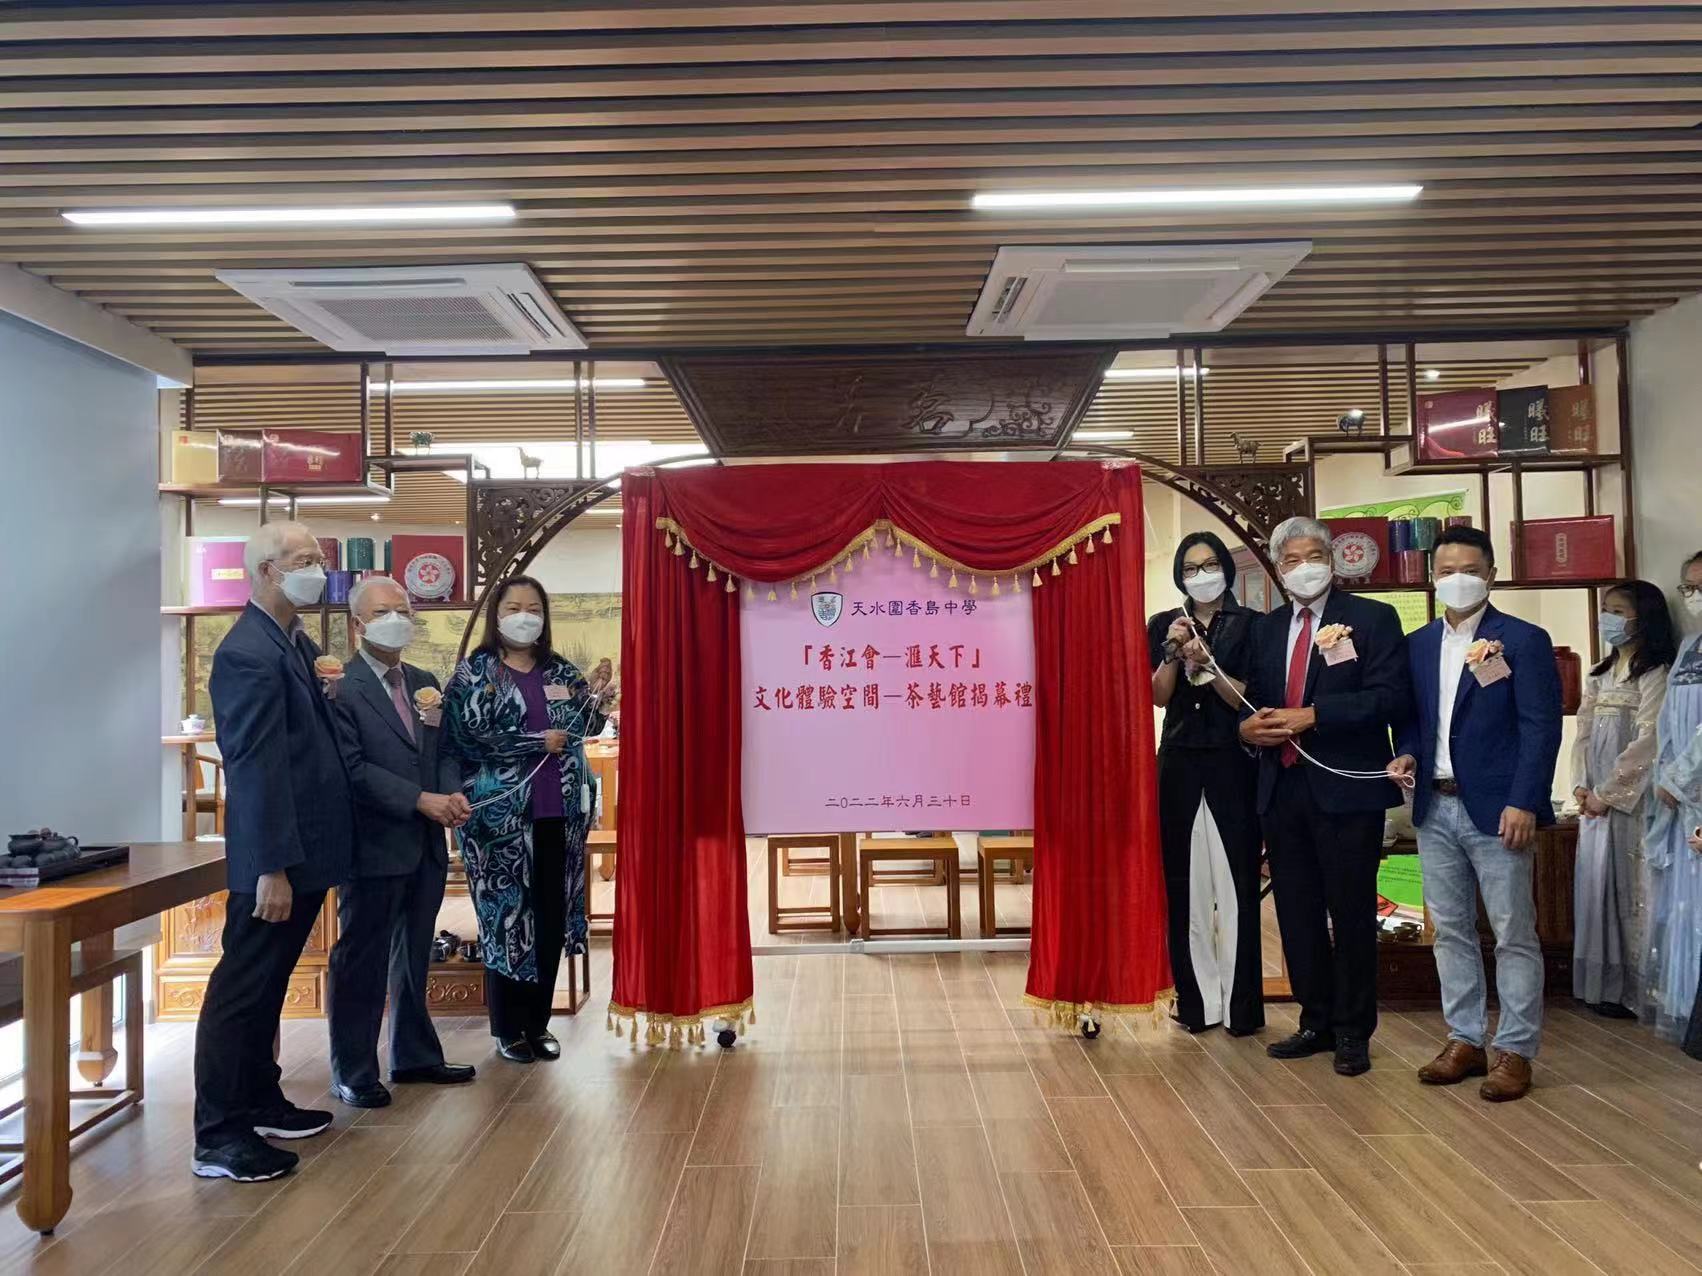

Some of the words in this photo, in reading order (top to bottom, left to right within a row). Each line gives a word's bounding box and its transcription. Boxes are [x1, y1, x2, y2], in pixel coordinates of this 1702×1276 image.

[851, 600, 977, 616] 天水圍香島中學
